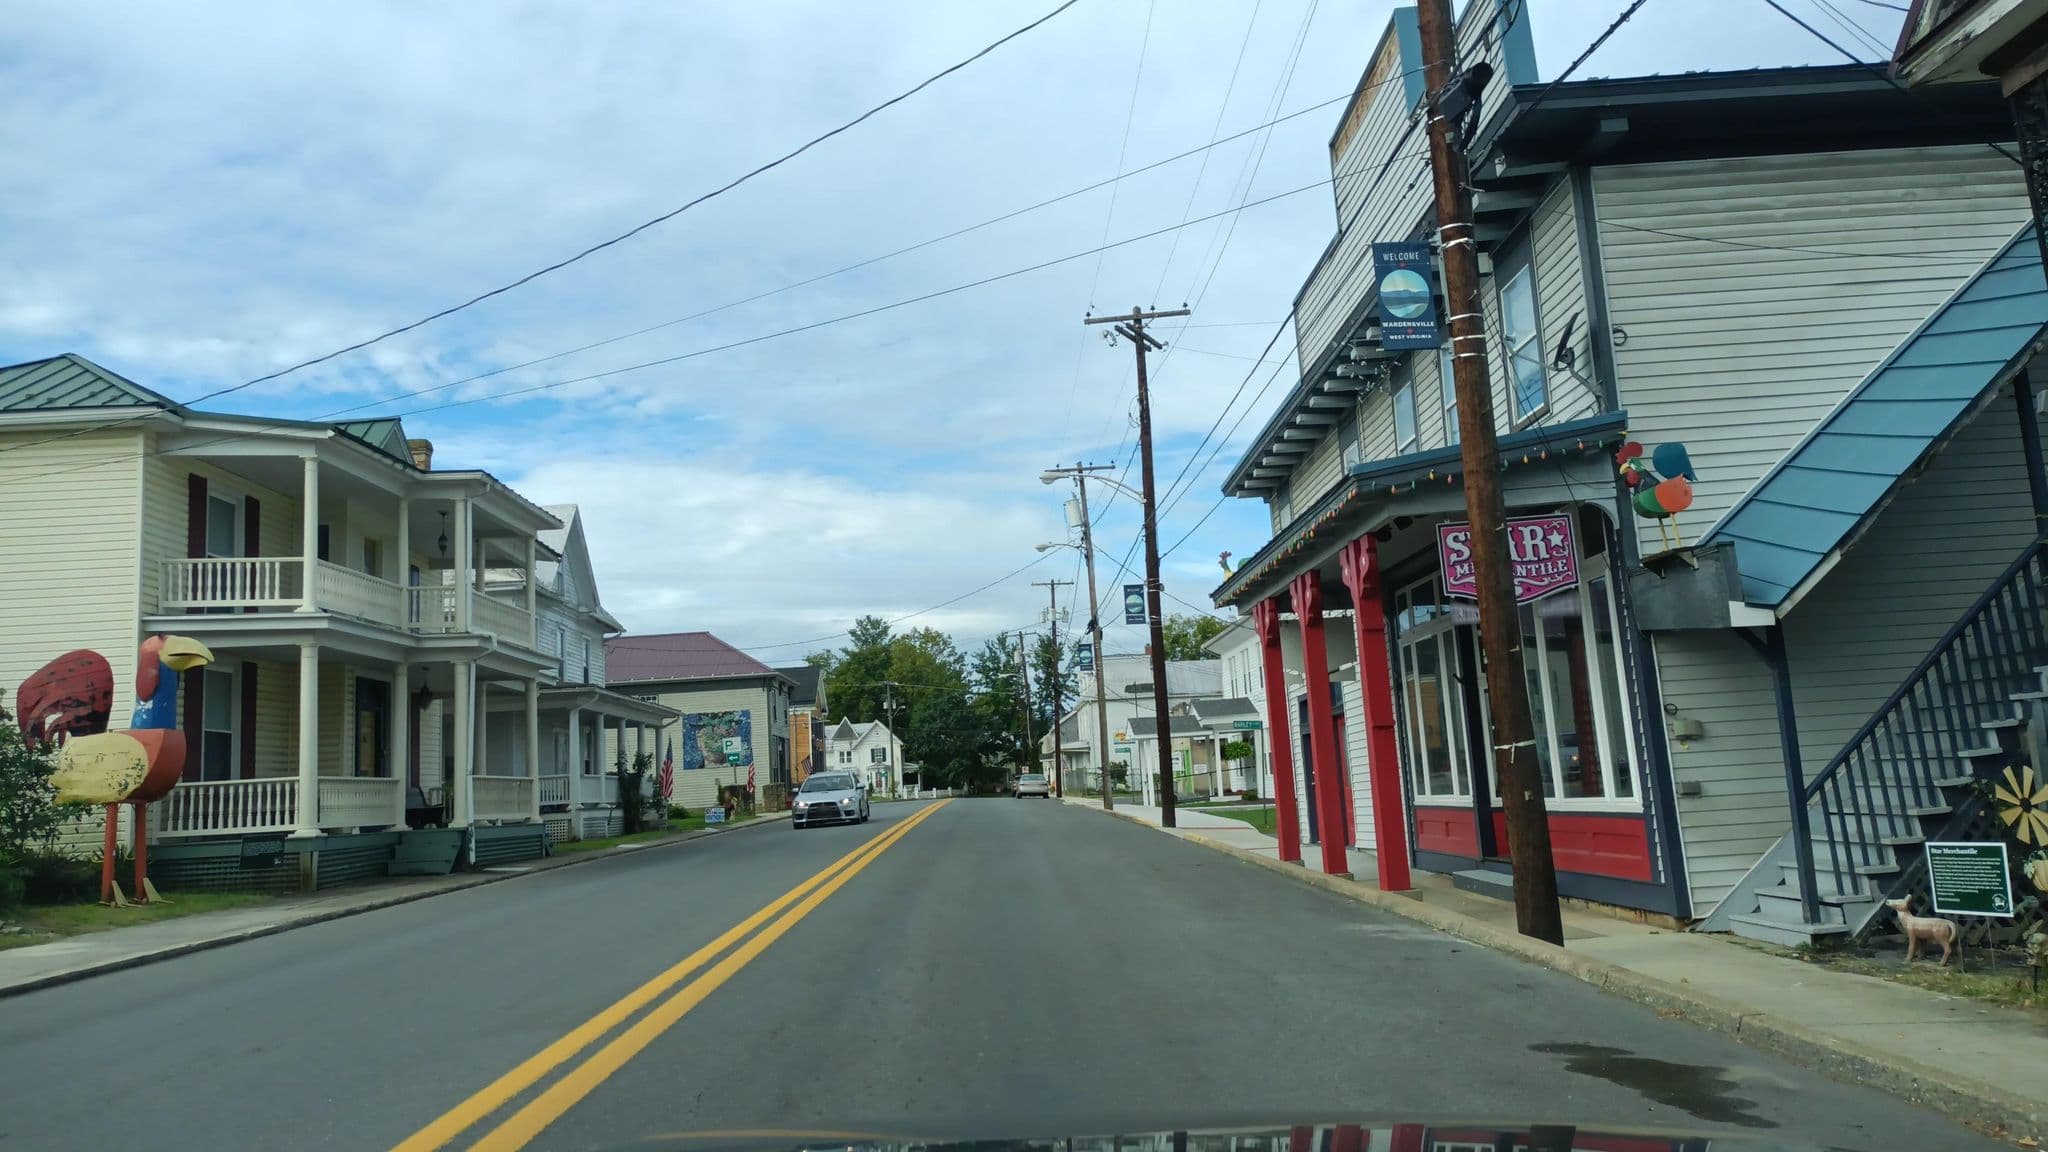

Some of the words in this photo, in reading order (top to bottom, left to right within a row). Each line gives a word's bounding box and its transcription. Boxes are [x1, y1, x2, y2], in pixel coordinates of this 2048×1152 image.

[1382, 252, 1420, 261] WELCOME
[1446, 525, 1550, 565] SAR
[1455, 559, 1568, 578] MNTILE
